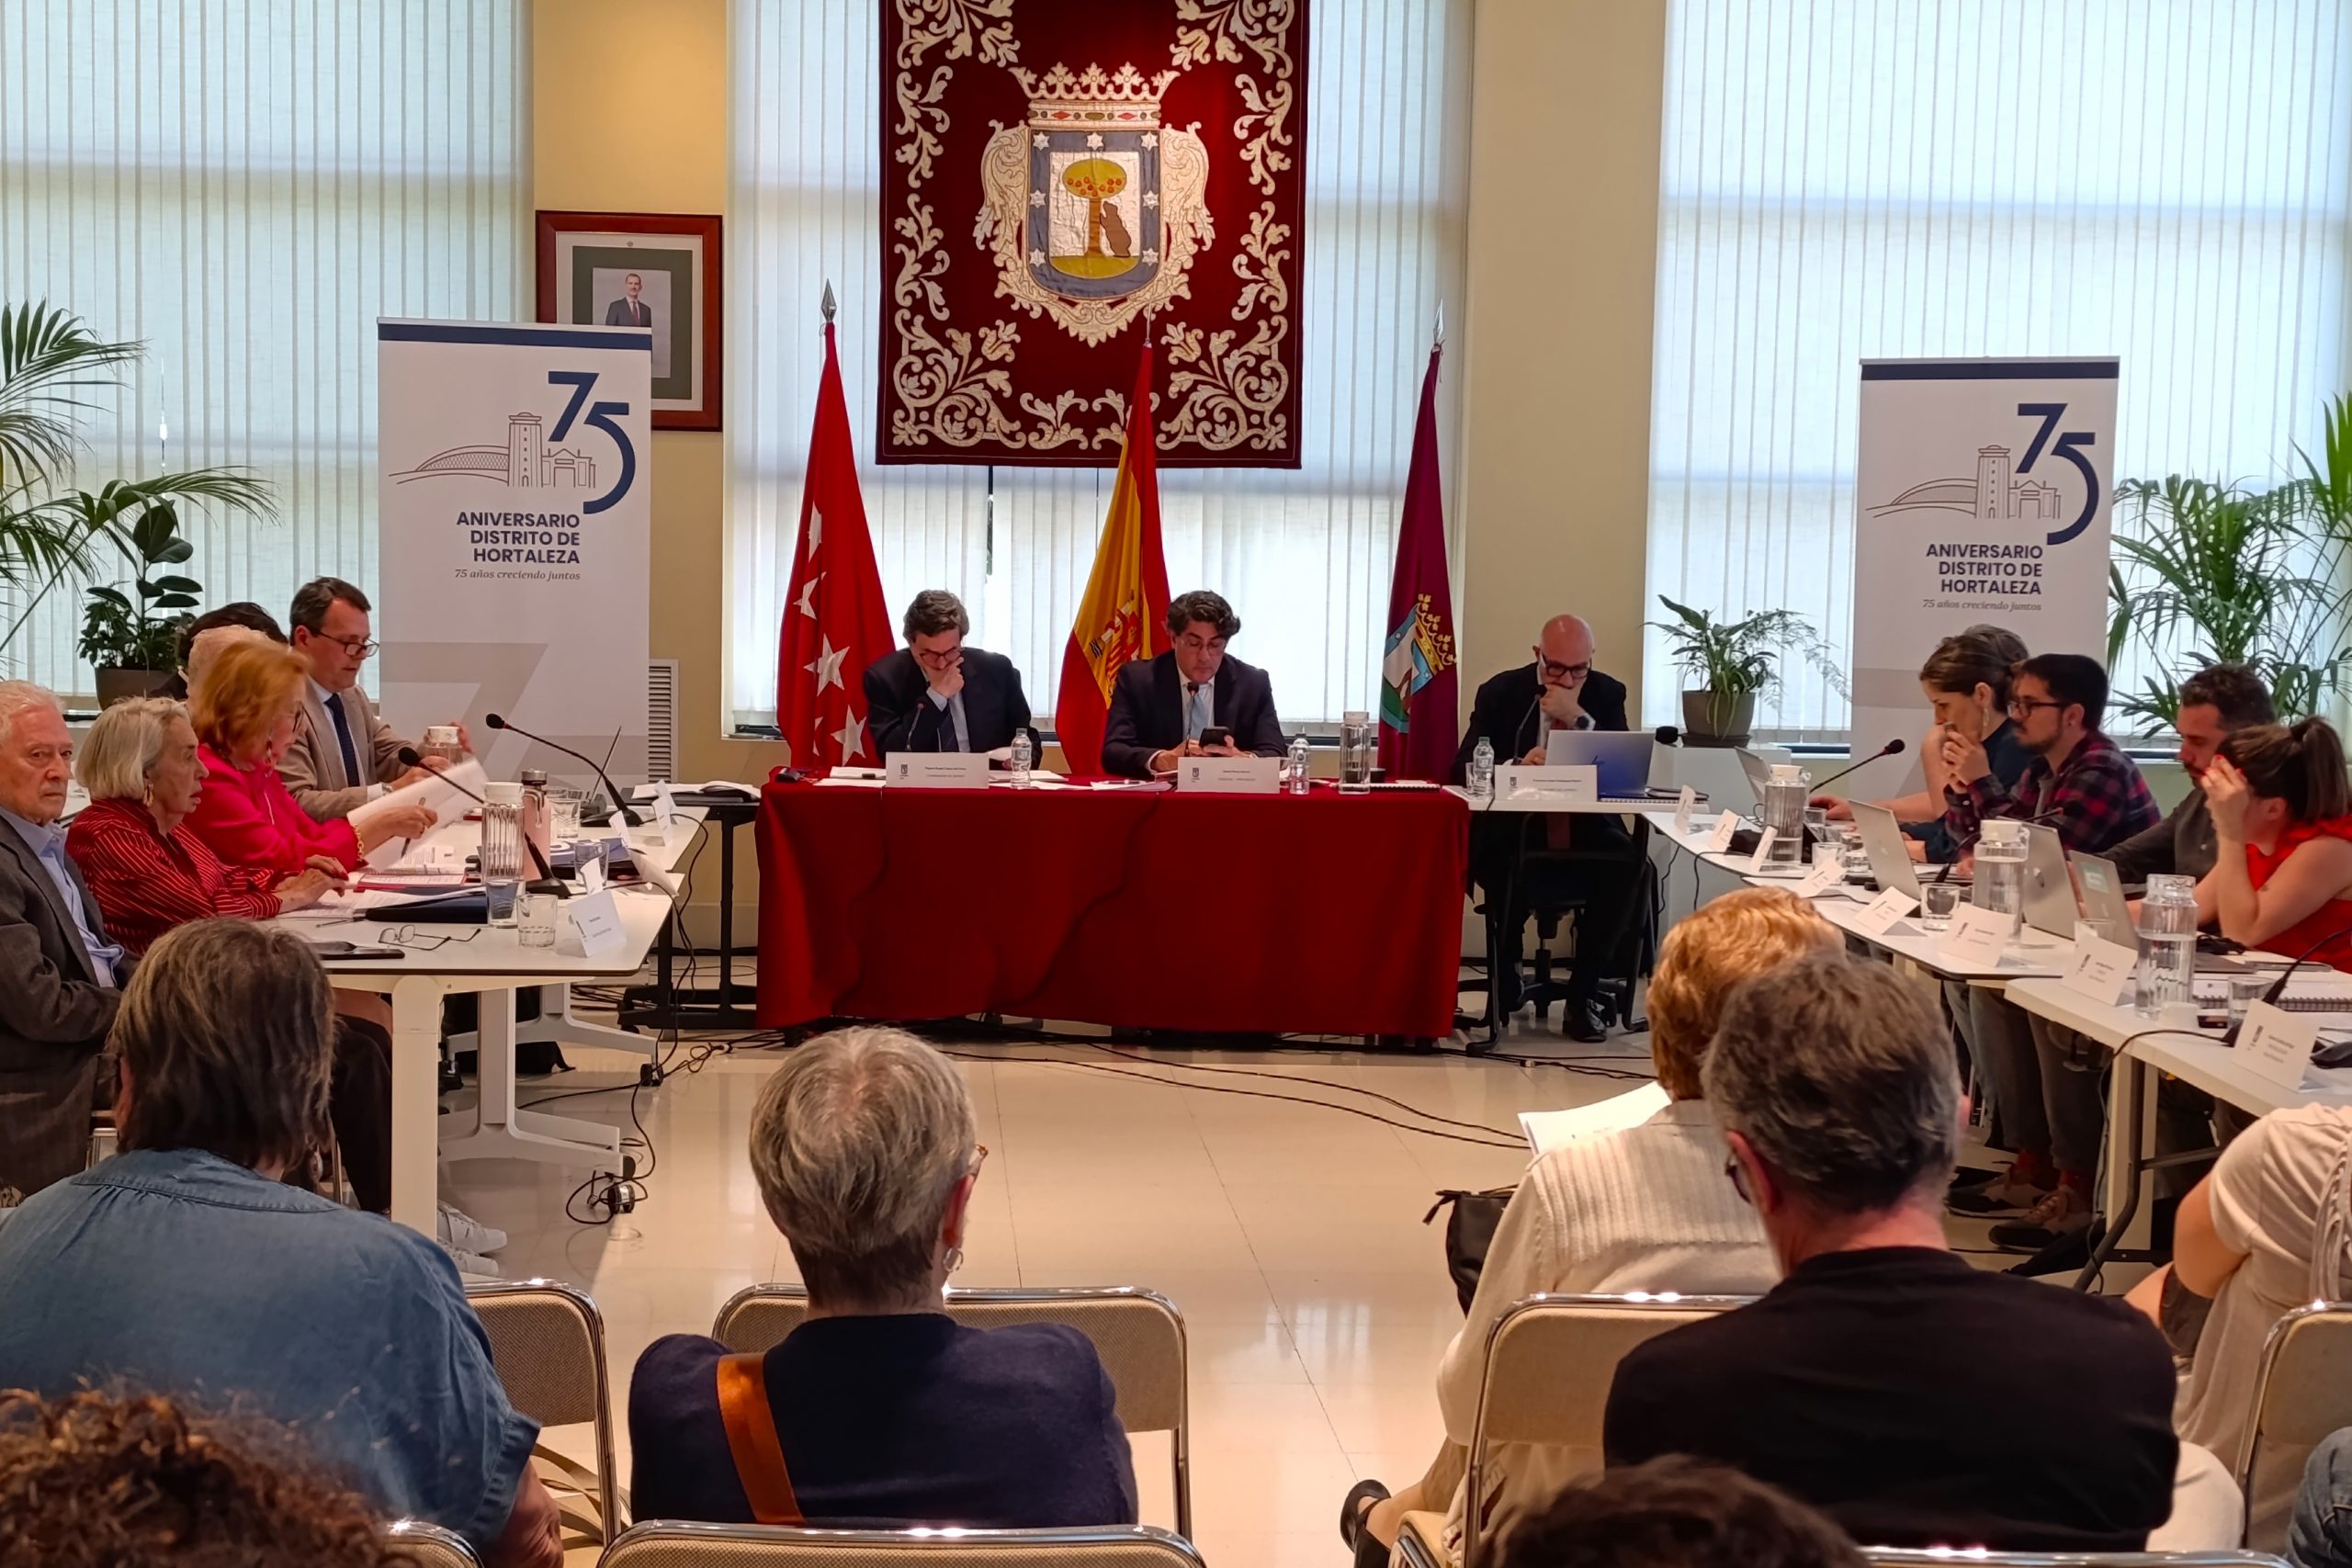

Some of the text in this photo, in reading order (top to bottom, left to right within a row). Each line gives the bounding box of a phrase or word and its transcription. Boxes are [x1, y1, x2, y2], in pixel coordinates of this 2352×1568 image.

[548, 371, 636, 514] 75
[2015, 403, 2099, 546] 75
[457, 512, 580, 528] ANIVERSARIO
[470, 530, 580, 546] DISTRITO DE
[474, 548, 580, 564] HORTALEZA
[1926, 544, 2042, 558] ANIVERSARIO
[456, 569, 582, 582] 75 años creciendo juntos
[1939, 561, 2042, 577] DISTRITO DE
[1941, 579, 2041, 594] HORTALEZA
[1923, 598, 2042, 614] 75 años creciendo juntos
